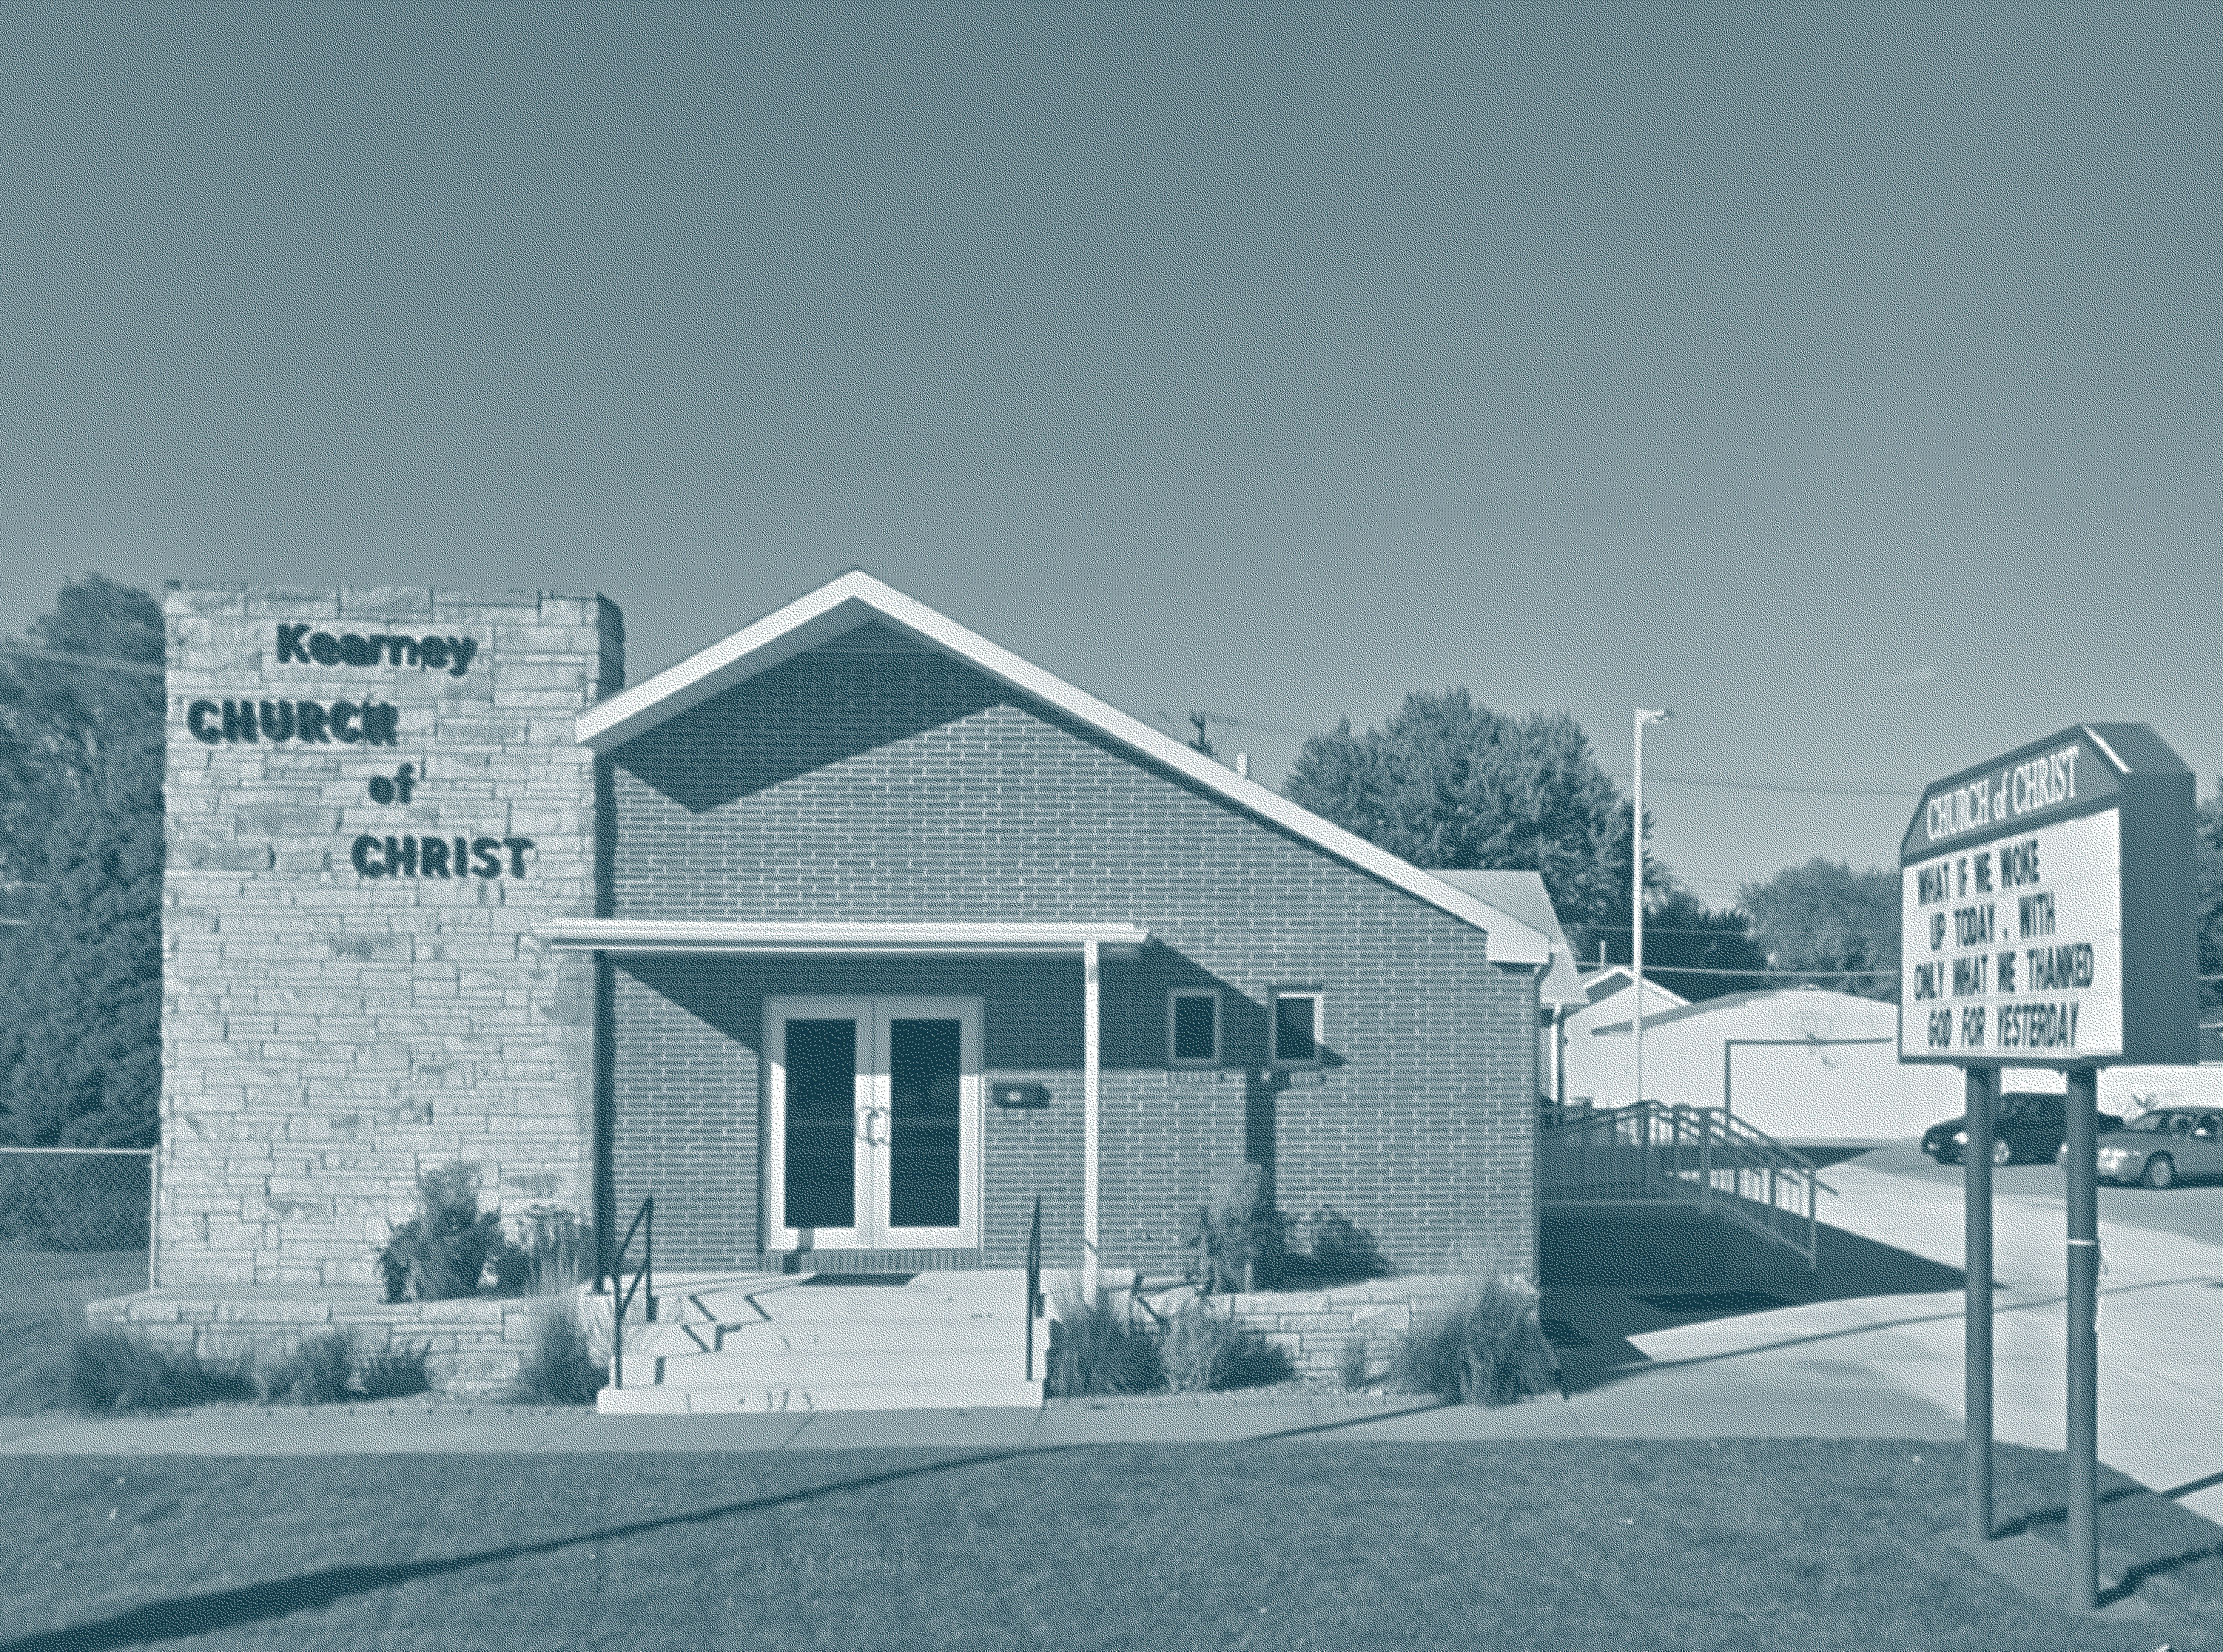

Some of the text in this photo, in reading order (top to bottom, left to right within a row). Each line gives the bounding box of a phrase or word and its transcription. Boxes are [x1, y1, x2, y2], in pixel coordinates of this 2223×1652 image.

[276, 623, 477, 676] Kearney
[186, 698, 399, 746] CHURCH
[369, 762, 417, 805] of
[1927, 744, 2079, 841] CHURCH of CHRIST
[350, 836, 535, 879] CHRIST
[1918, 839, 2040, 906] WHAT IF WE WOKE
[1929, 911, 1945, 951] UP
[2018, 890, 2056, 940] WITH
[1914, 942, 2094, 1001] ONLY WHAT WE THANKED
[1928, 1001, 2079, 1048] GOD FOR YESTERDAY
